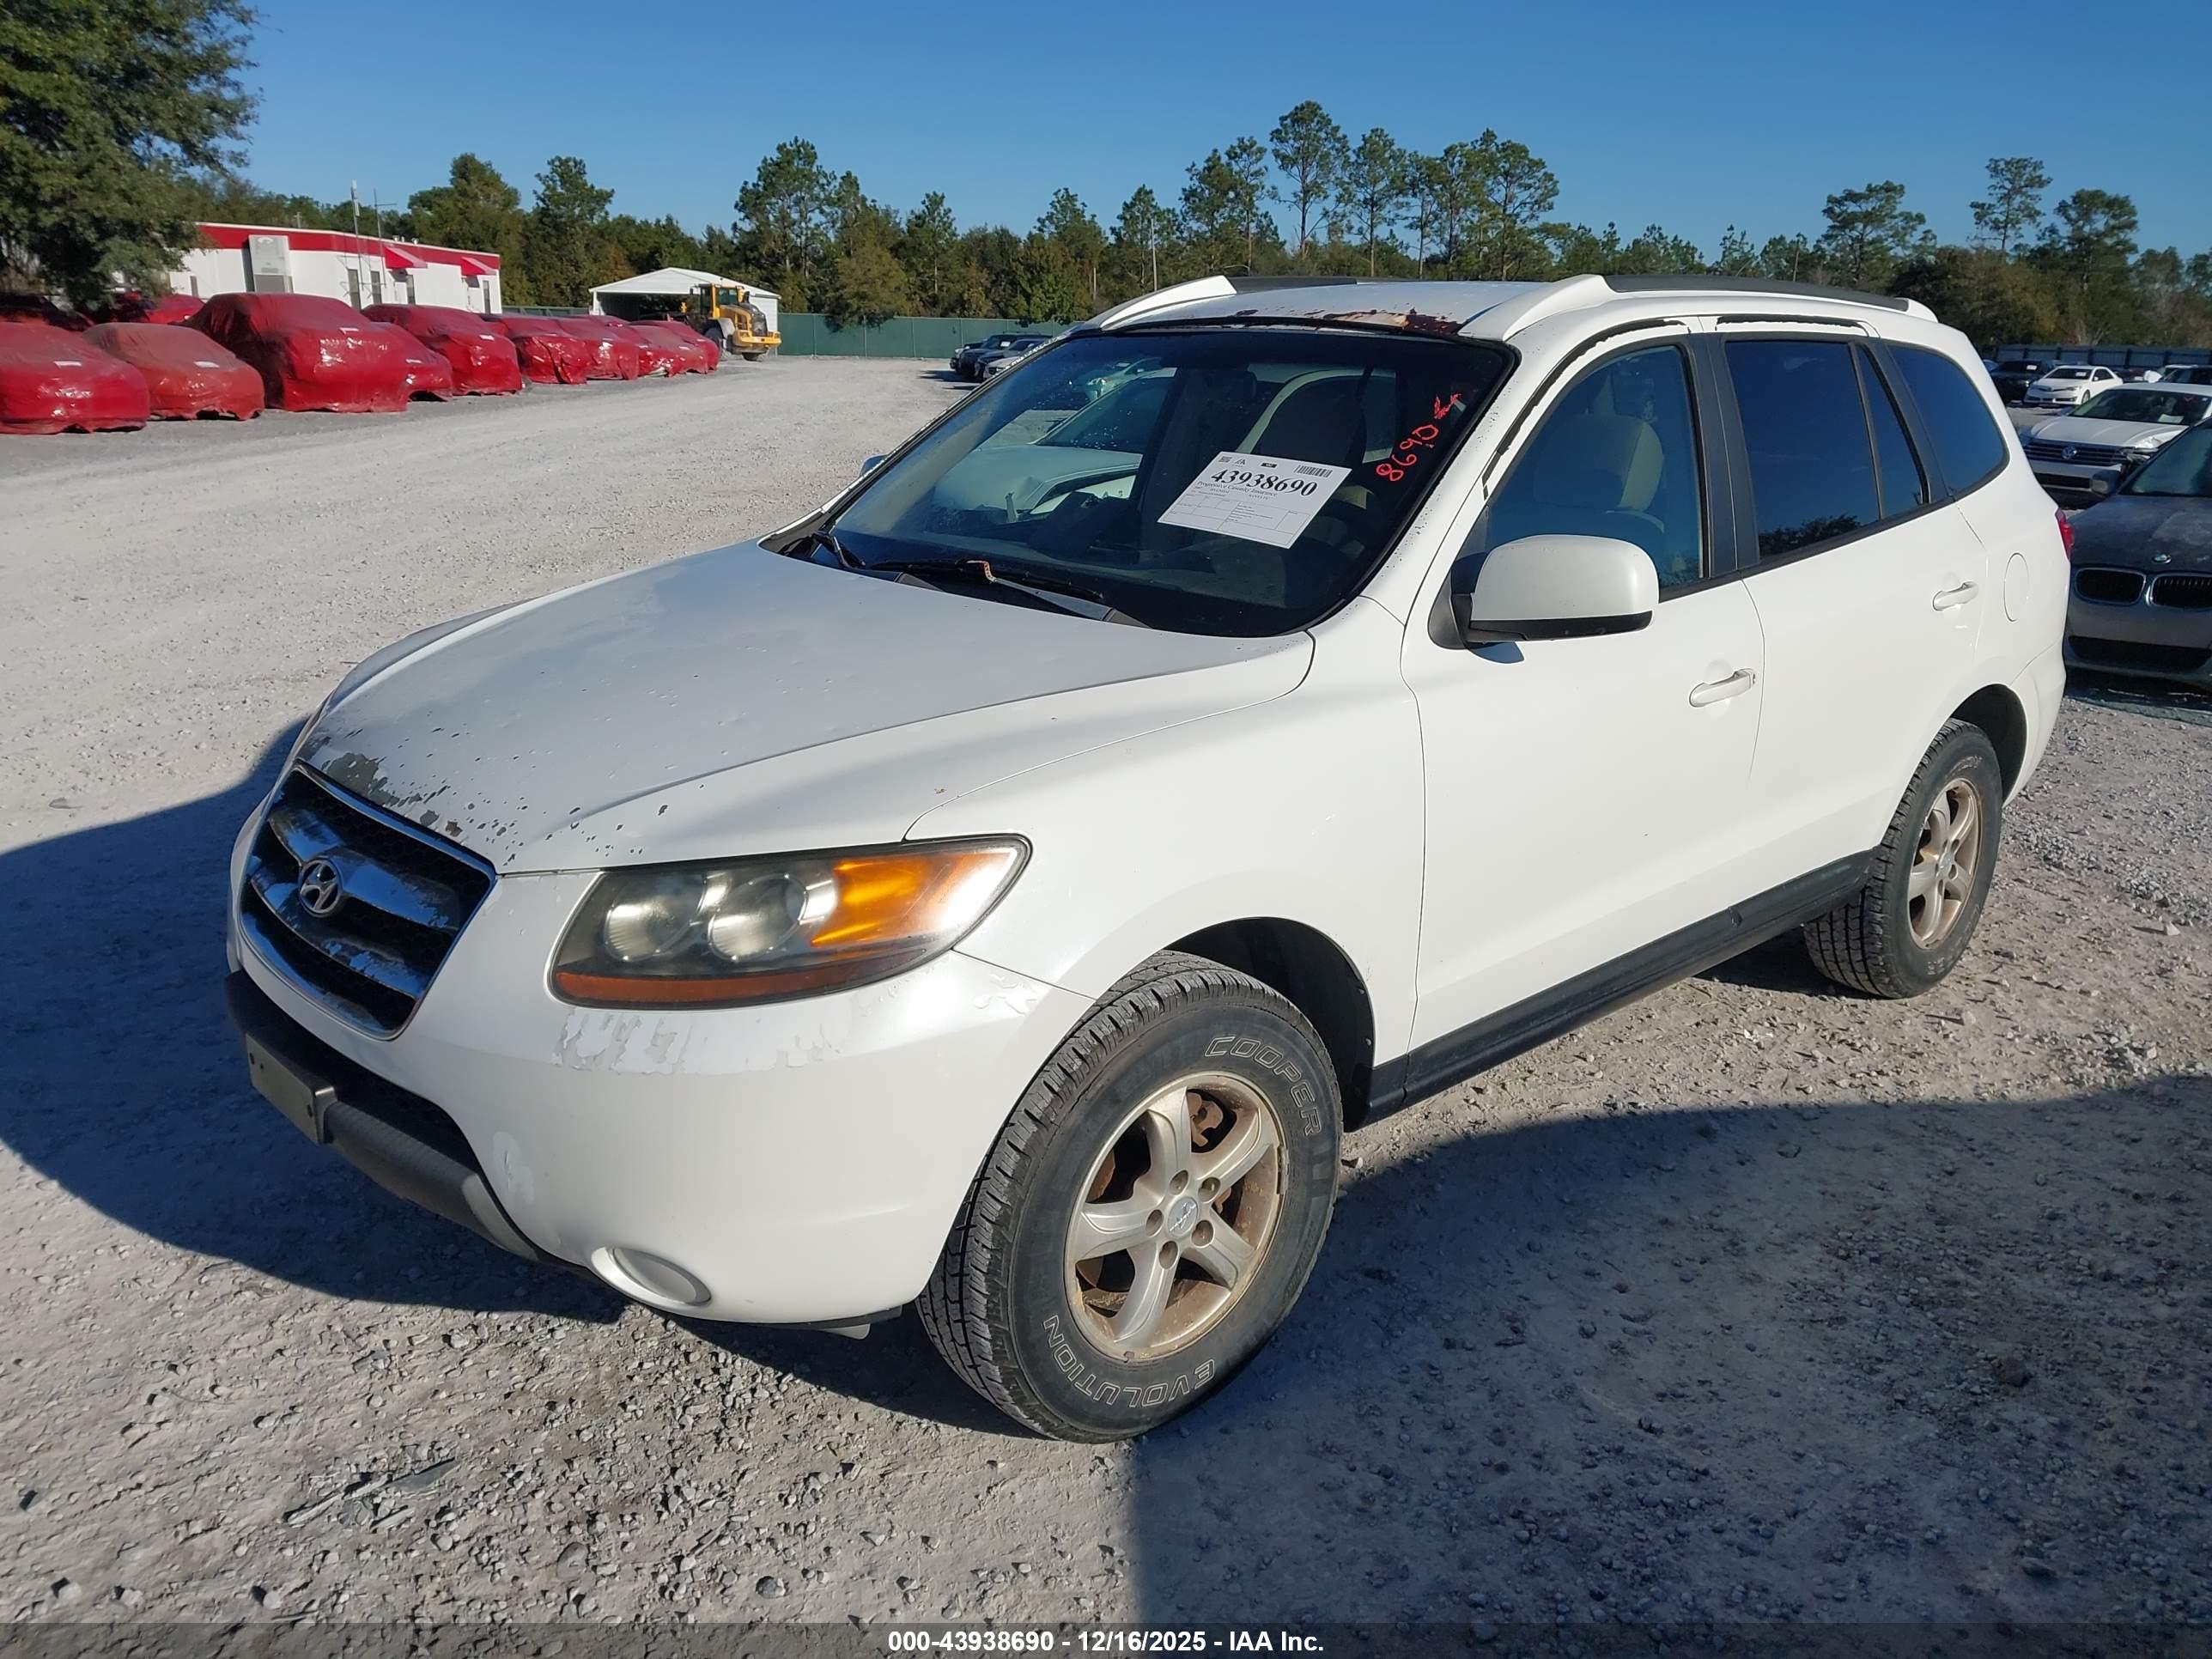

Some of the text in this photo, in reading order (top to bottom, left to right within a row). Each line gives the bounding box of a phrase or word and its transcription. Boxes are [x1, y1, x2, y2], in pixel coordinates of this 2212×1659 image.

[1211, 469, 1318, 496] 43938690
[1376, 423, 1439, 482] 8690
[1204, 1036, 1322, 1136] COOPER
[1043, 1315, 1215, 1407] EVOLUTION
